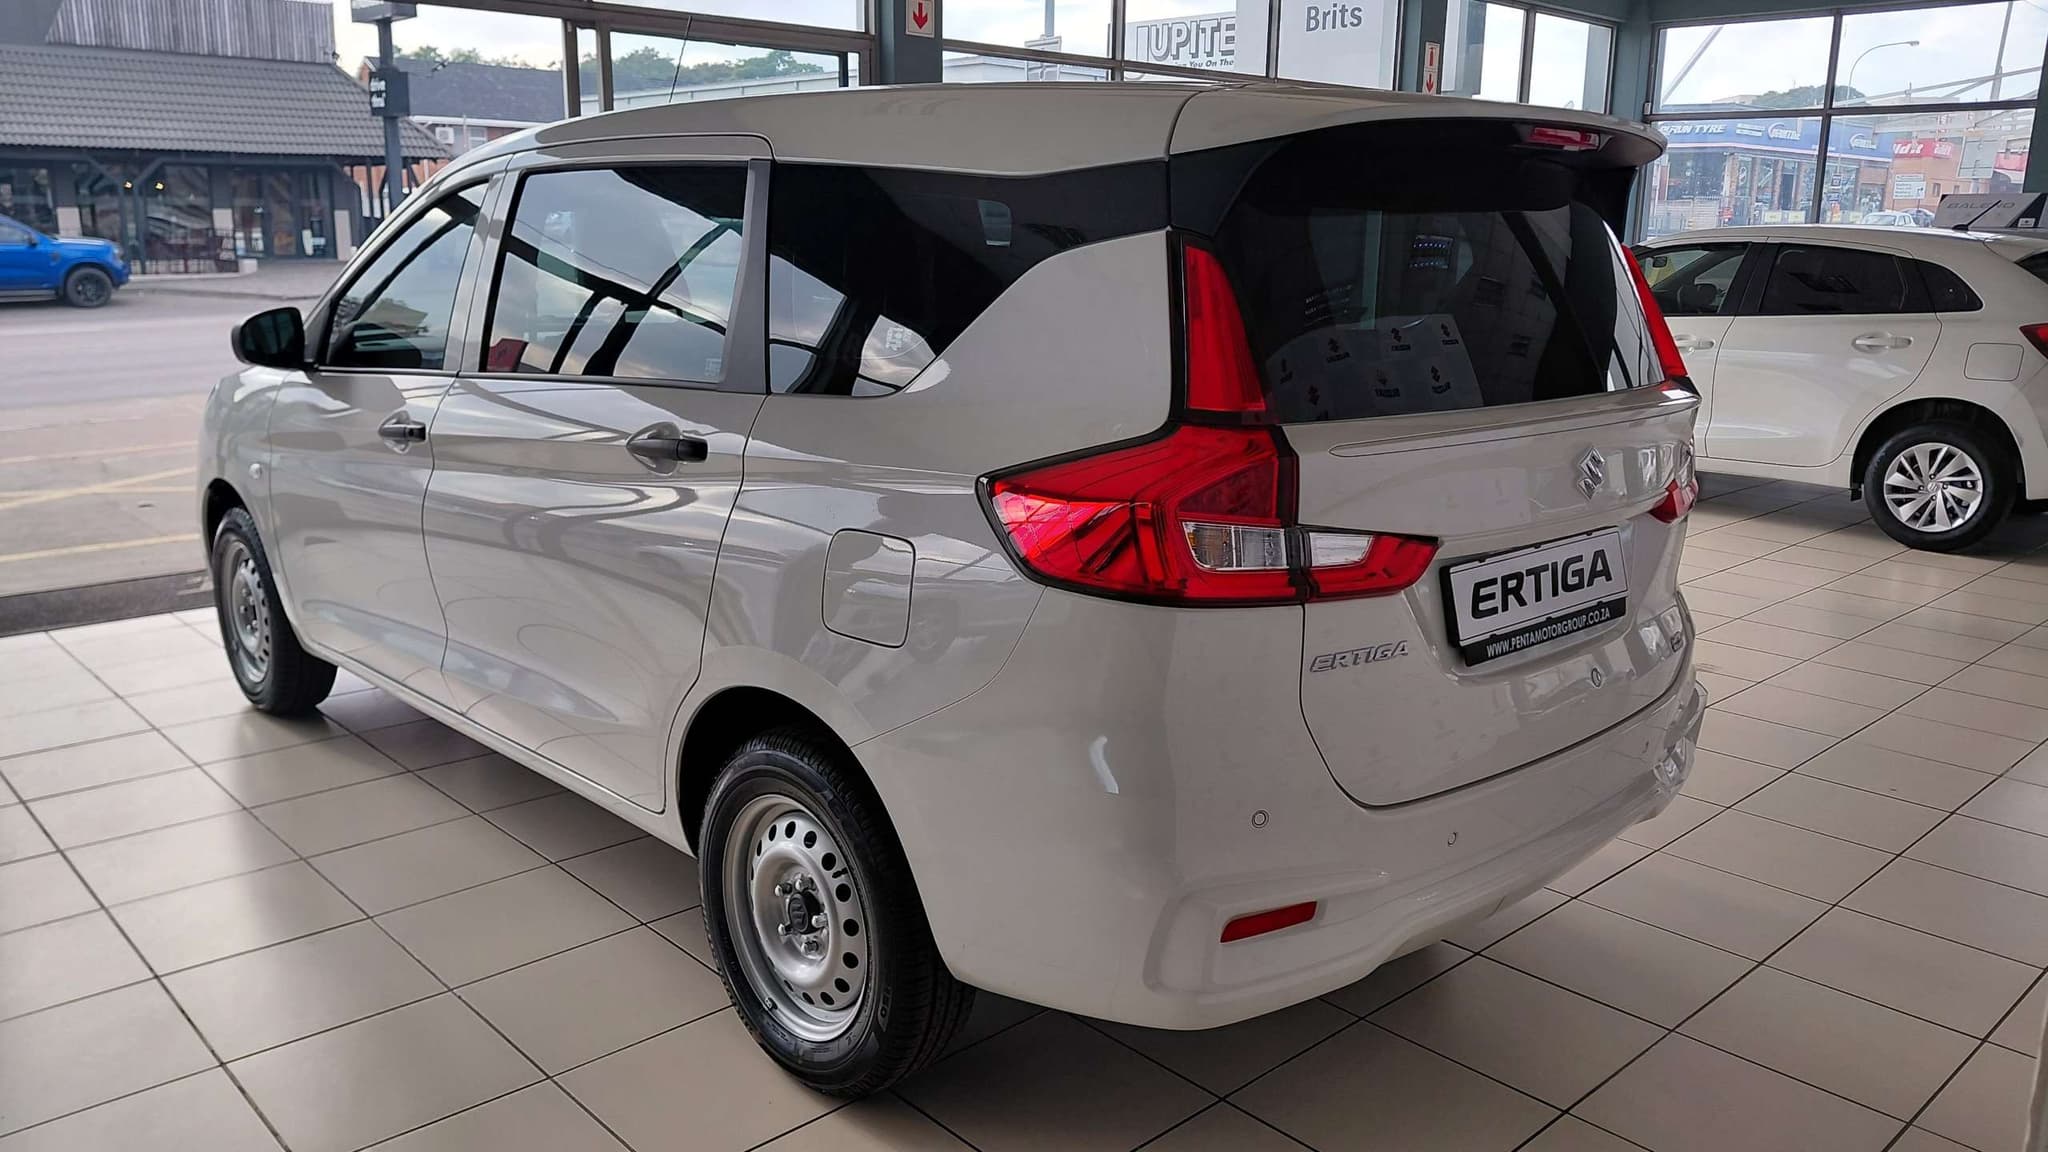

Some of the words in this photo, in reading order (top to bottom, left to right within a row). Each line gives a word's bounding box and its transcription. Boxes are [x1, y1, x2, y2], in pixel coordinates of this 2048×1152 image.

[1305, 3, 1363, 32] Brits
[1219, 58, 1234, 66] The
[1471, 549, 1613, 620] ERTIGA
[1486, 607, 1611, 658] WWW.PENTAMOTORGROUP.CO.ZA
[1310, 640, 1408, 672] ERTIGA
